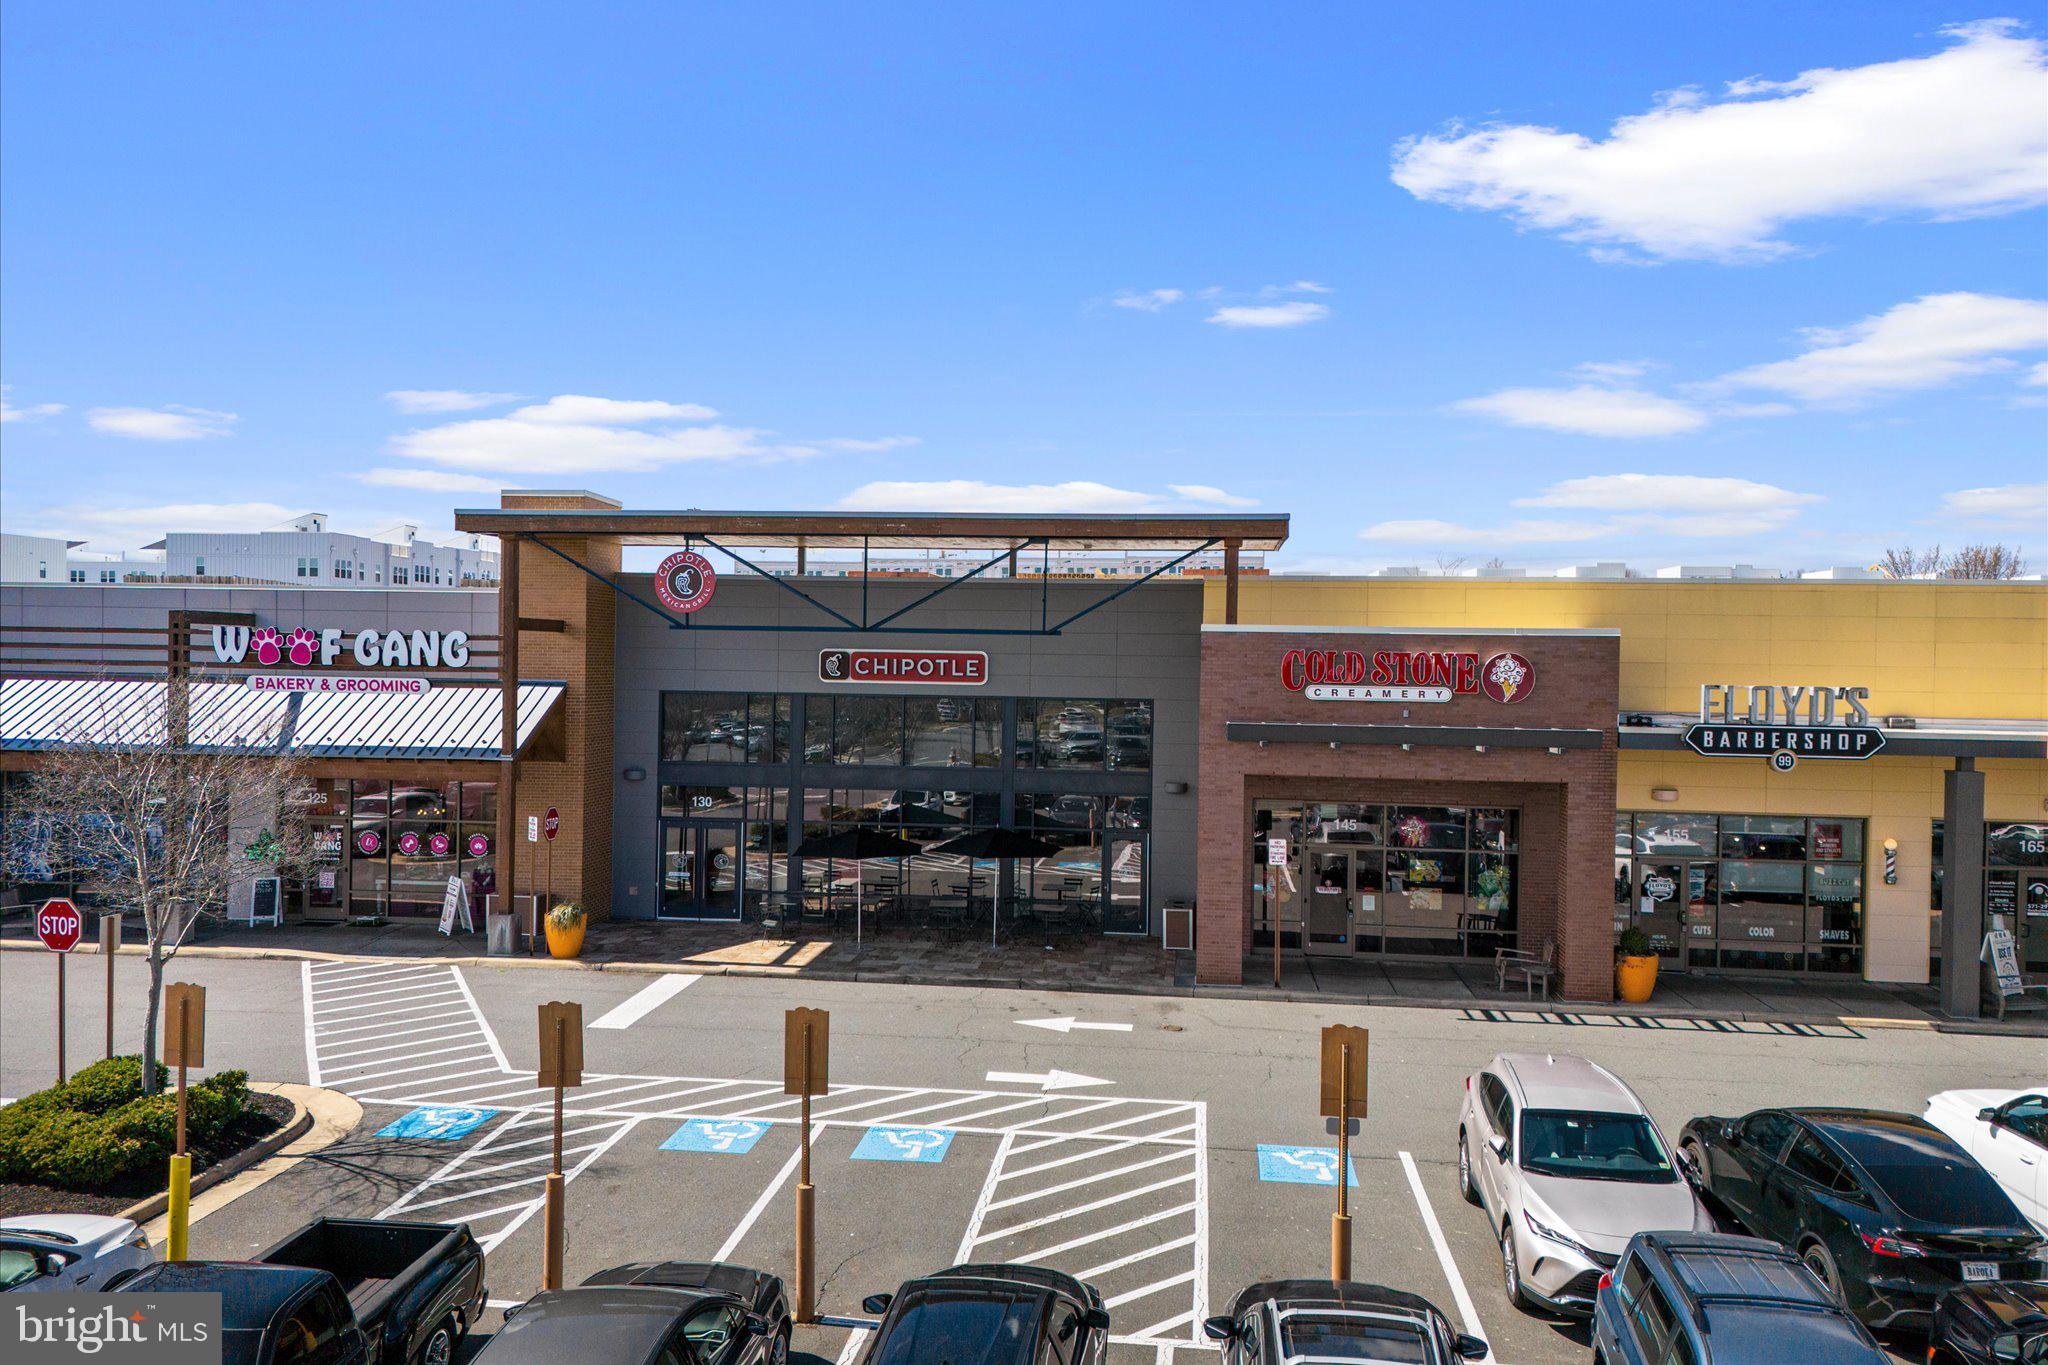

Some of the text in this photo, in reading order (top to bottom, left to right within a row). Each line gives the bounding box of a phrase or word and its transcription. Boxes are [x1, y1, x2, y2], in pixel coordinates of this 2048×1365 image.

[658, 554, 712, 578] CHIPOTLE
[659, 587, 711, 609] MEXICAN GRILL
[354, 629, 469, 668] GANG
[855, 657, 979, 676] CHIPOTLE
[1281, 649, 1480, 694] COLD STONE
[255, 677, 421, 692] BAKERY & GROOMING
[1314, 688, 1444, 699] CREAMERY
[1701, 684, 1869, 726] FLOYD'S
[1703, 731, 1867, 750] BARBERSHOP
[1778, 755, 1792, 767] 99
[307, 792, 328, 804] 125
[692, 796, 713, 807] 130
[1334, 819, 1357, 831] 145
[1665, 829, 1689, 841] 155
[2019, 840, 2045, 853] 165
[41, 915, 77, 935] STOP
[1692, 925, 1712, 935] CUTS
[1748, 926, 1775, 937] COLOR
[1819, 929, 1850, 940] SHAVES
